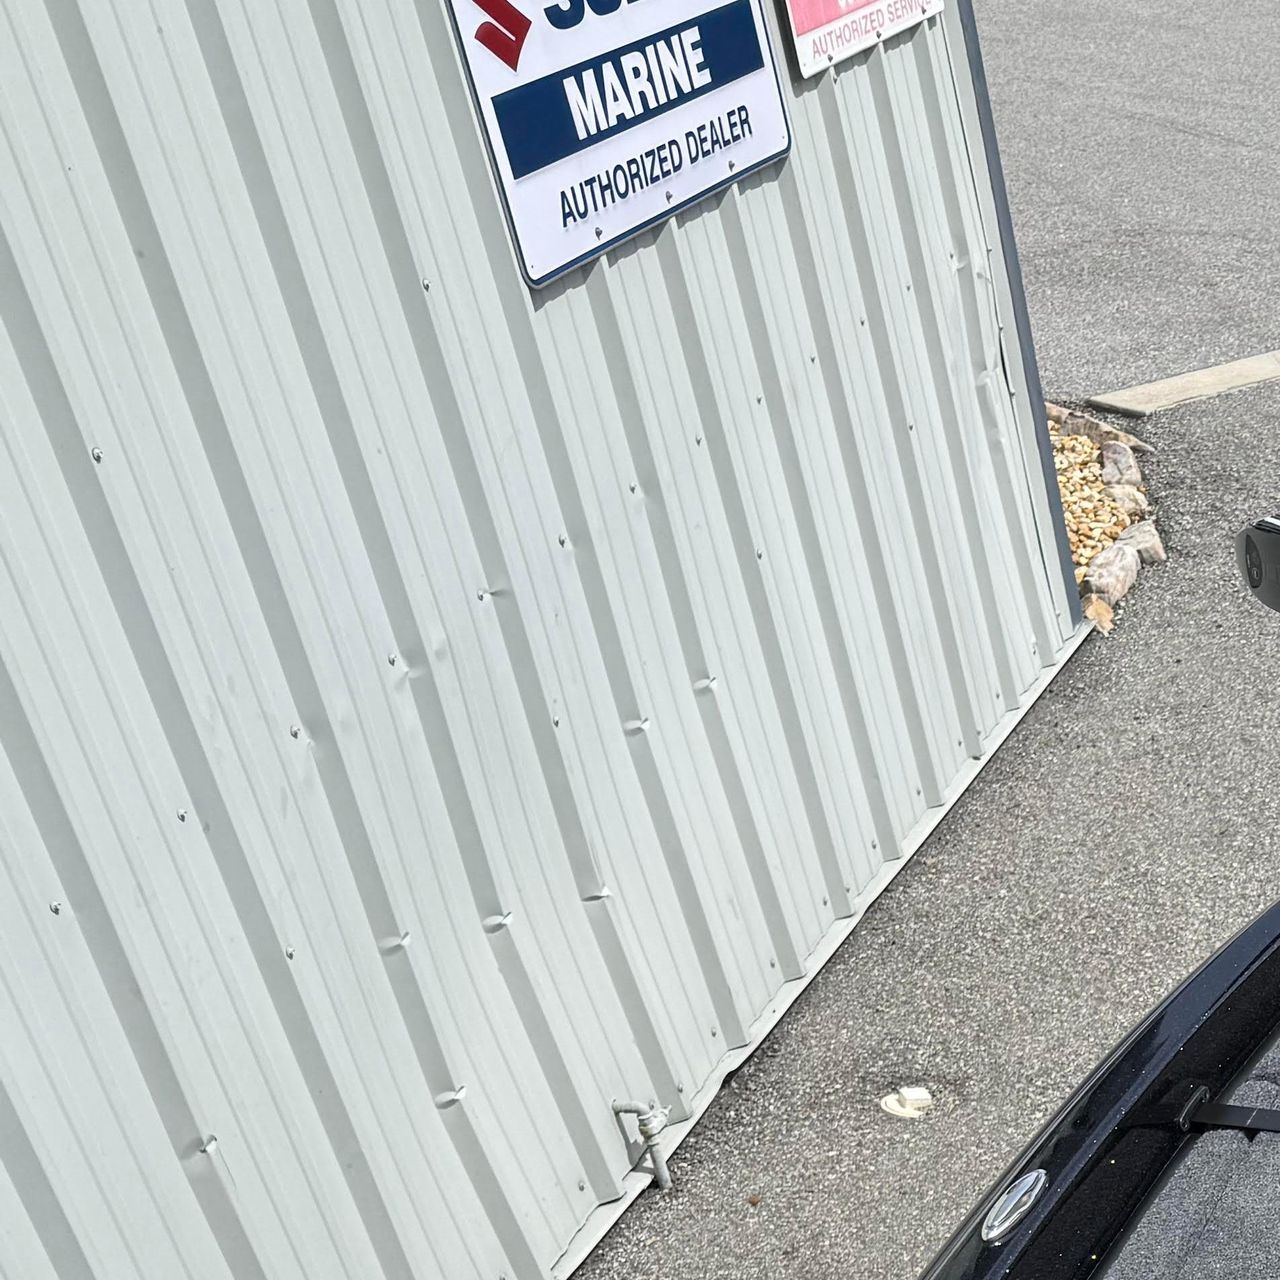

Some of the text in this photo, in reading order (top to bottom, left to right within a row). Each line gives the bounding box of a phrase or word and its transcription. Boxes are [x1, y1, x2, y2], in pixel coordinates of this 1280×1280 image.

[561, 25, 712, 142] MARINE
[812, 0, 931, 60] AUTHORIZED SERVI
[559, 104, 753, 228] AUTHORIZED DEALER
